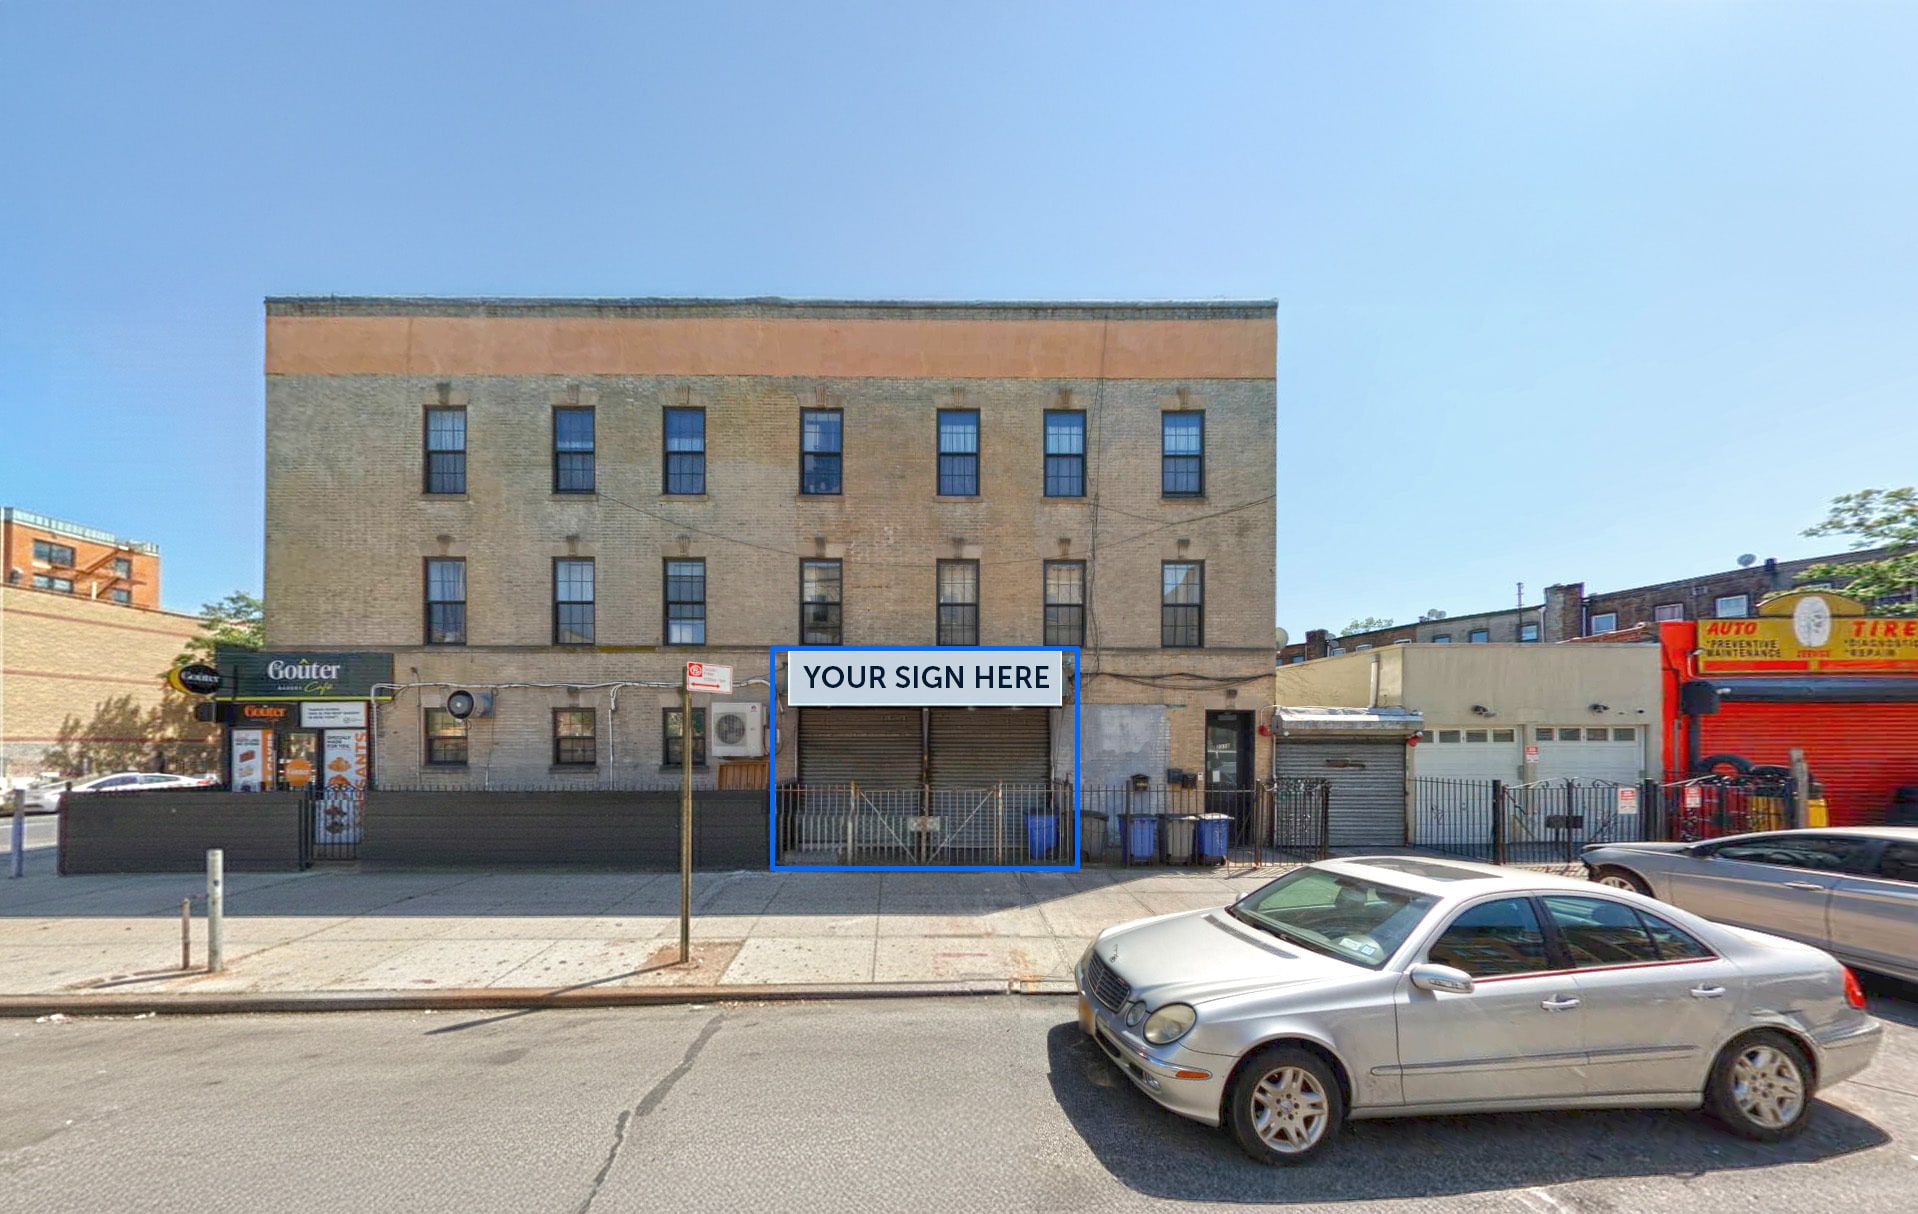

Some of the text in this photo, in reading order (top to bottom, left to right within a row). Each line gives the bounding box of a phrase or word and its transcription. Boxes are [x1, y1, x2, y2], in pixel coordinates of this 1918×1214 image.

[1706, 621, 1758, 636] AUTO
[1852, 620, 1917, 638] TIRE
[1706, 649, 1781, 658] MAINTENANCE
[268, 658, 341, 680] Goûter
